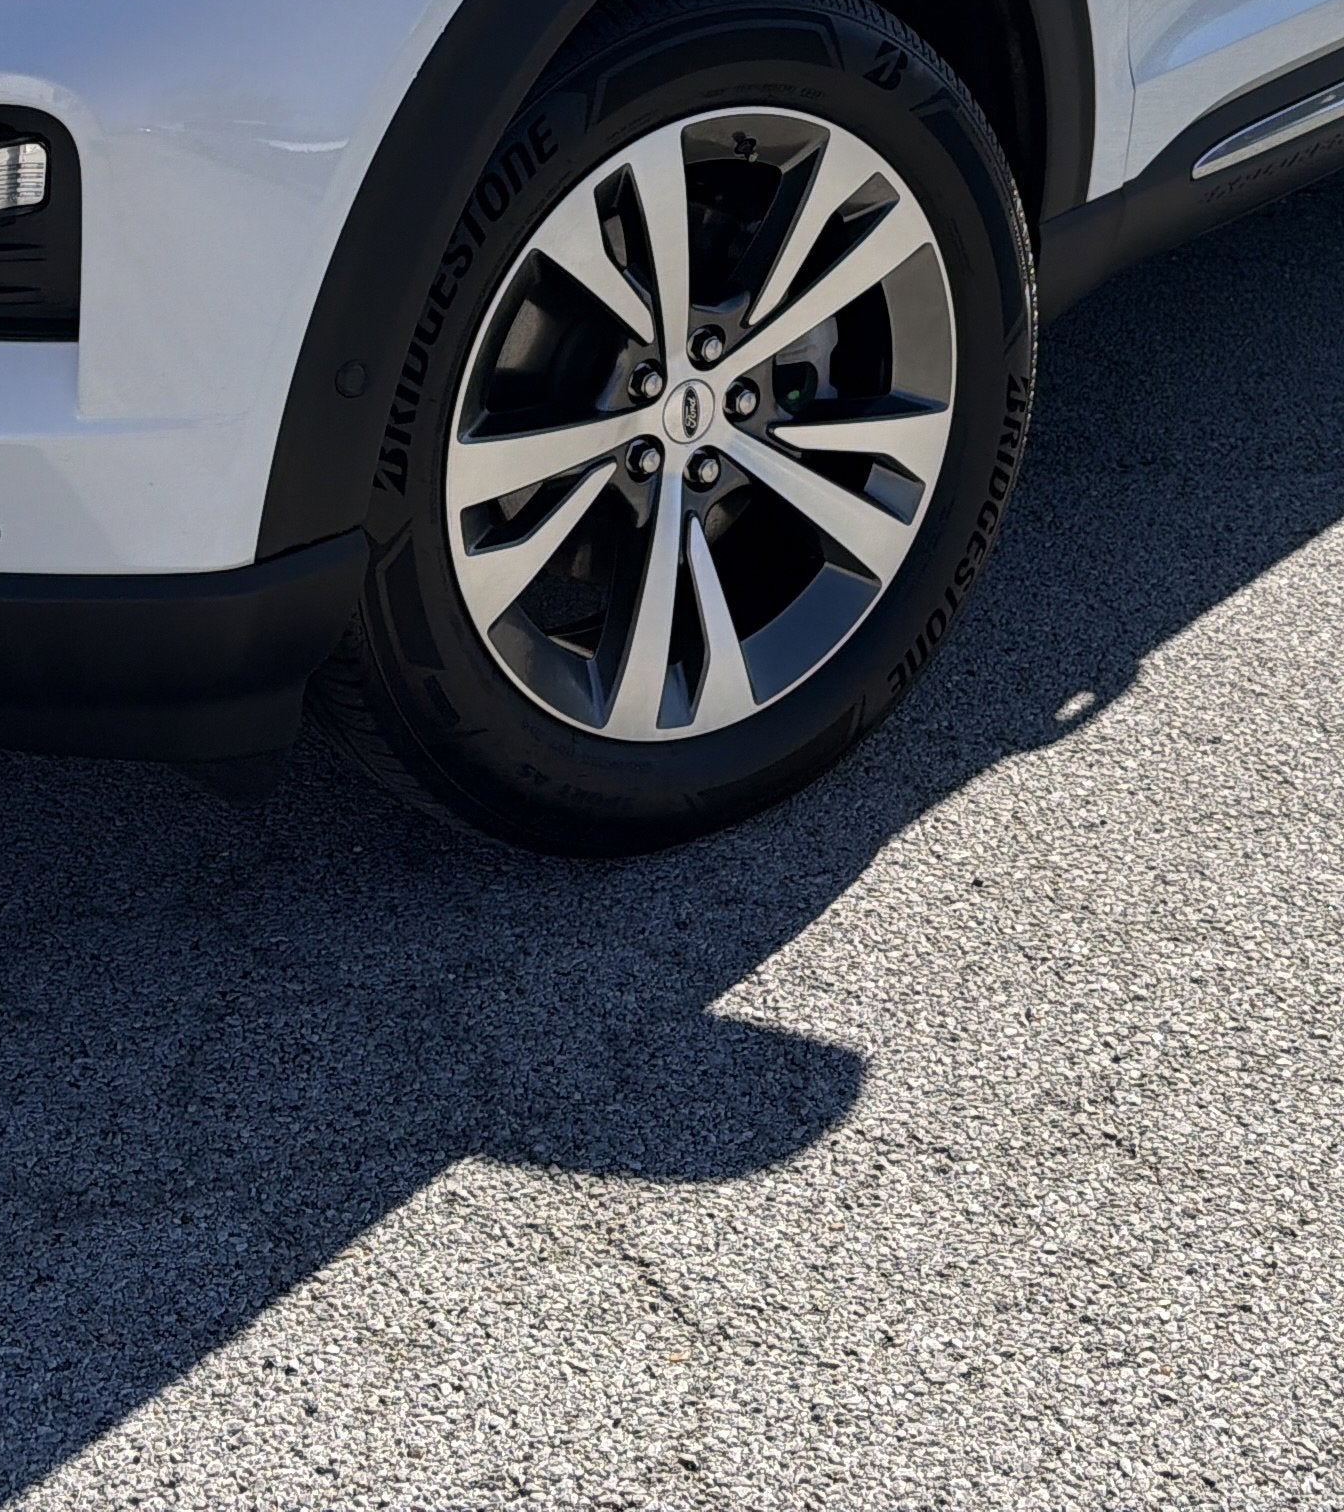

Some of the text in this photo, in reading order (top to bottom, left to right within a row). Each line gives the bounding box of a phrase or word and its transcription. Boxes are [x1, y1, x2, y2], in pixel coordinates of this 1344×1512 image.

[374, 116, 559, 496] BRIDGESTONE
[685, 395, 697, 428] Ford
[886, 372, 1031, 694] BRIDGESTONE
